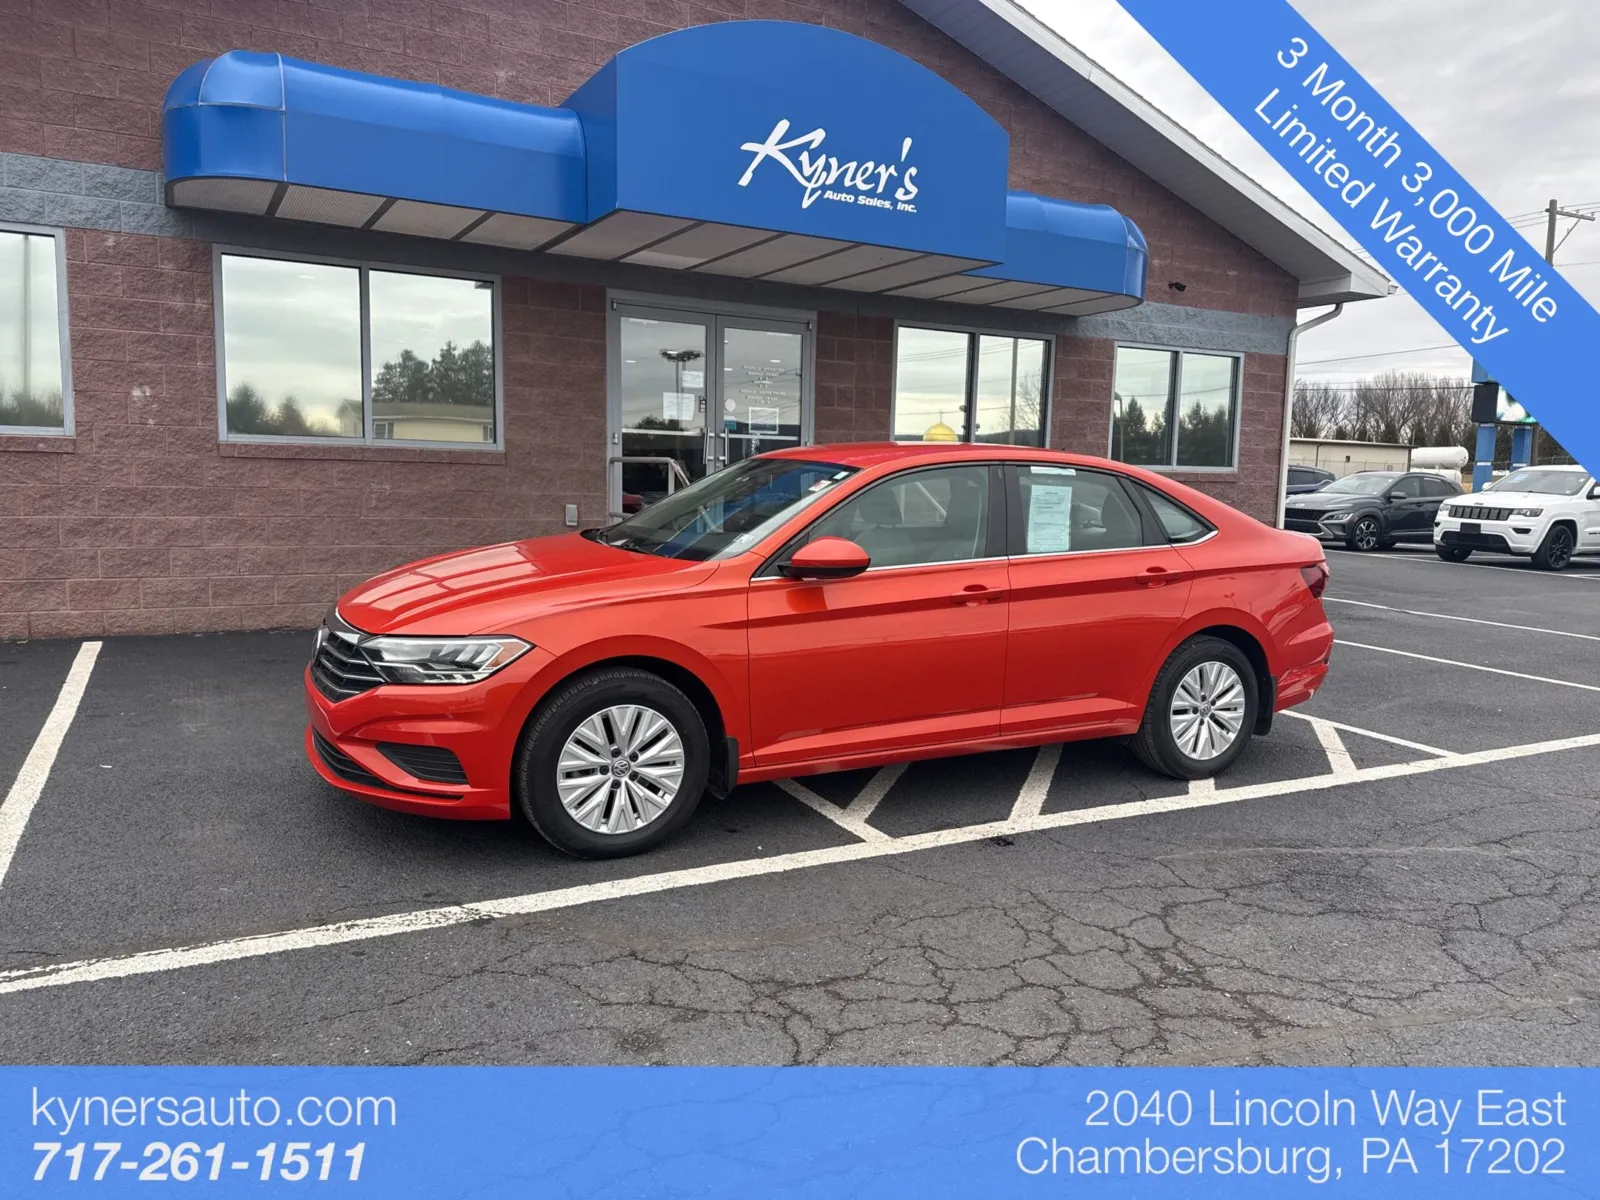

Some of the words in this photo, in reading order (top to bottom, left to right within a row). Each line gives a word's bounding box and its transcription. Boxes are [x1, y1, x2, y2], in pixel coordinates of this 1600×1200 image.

[737, 118, 919, 209] Kyner's
[823, 189, 855, 204] Auto
[857, 195, 893, 210] Sales,
[897, 201, 917, 213] Inc.
